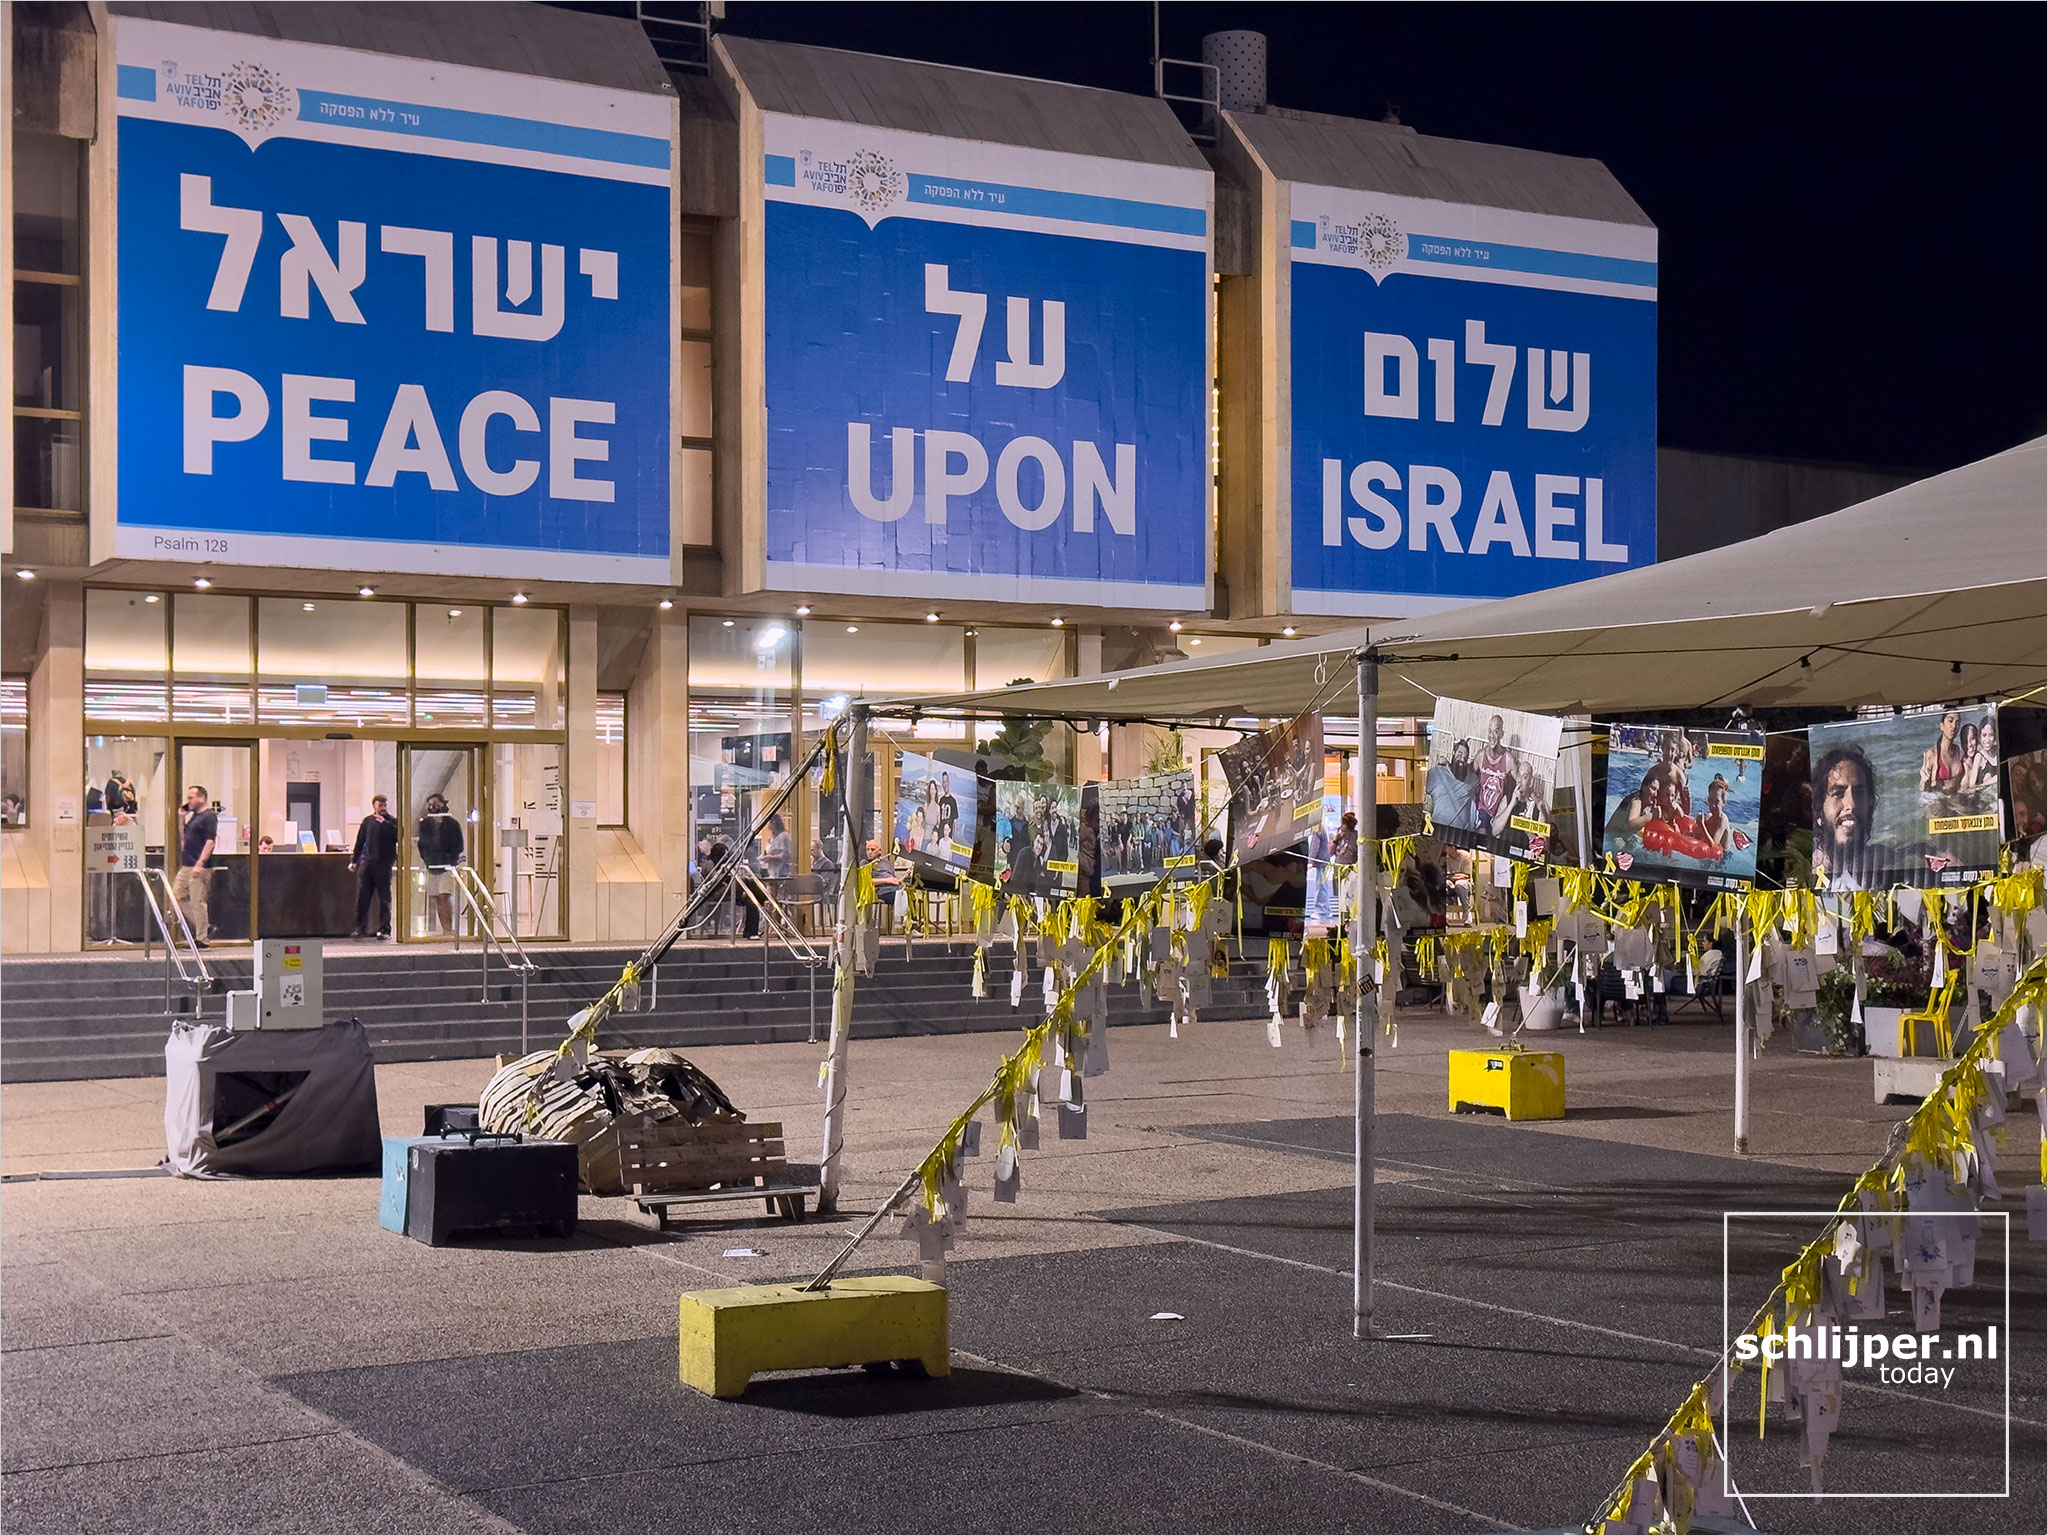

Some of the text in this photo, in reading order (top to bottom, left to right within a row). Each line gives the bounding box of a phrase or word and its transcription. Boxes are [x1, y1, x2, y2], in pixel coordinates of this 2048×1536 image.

[185, 73, 204, 86] TEL
[204, 74, 221, 88] תל
[166, 82, 191, 96] AVIV
[193, 86, 221, 99] אביב
[176, 95, 205, 109] YAFO
[205, 99, 221, 110] יפו
[320, 102, 420, 126] עיר ללא הפסקה
[817, 161, 833, 172] TEL
[833, 161, 847, 174] תל
[803, 169, 823, 181] AVIV
[824, 172, 847, 184] אביב
[811, 180, 834, 192] YAFO
[834, 184, 847, 194] יפו
[924, 184, 1005, 204] עיר ללא הפסקה
[179, 172, 619, 342] ישראל
[1421, 243, 1490, 260] עיר ללא הפסקה
[924, 262, 1066, 390] על
[1363, 319, 1590, 433] שלום
[182, 363, 616, 504] PEACE
[847, 421, 1137, 536] UPON
[1322, 457, 1629, 564] ISRAEL
[153, 535, 228, 553] Psalm 128
